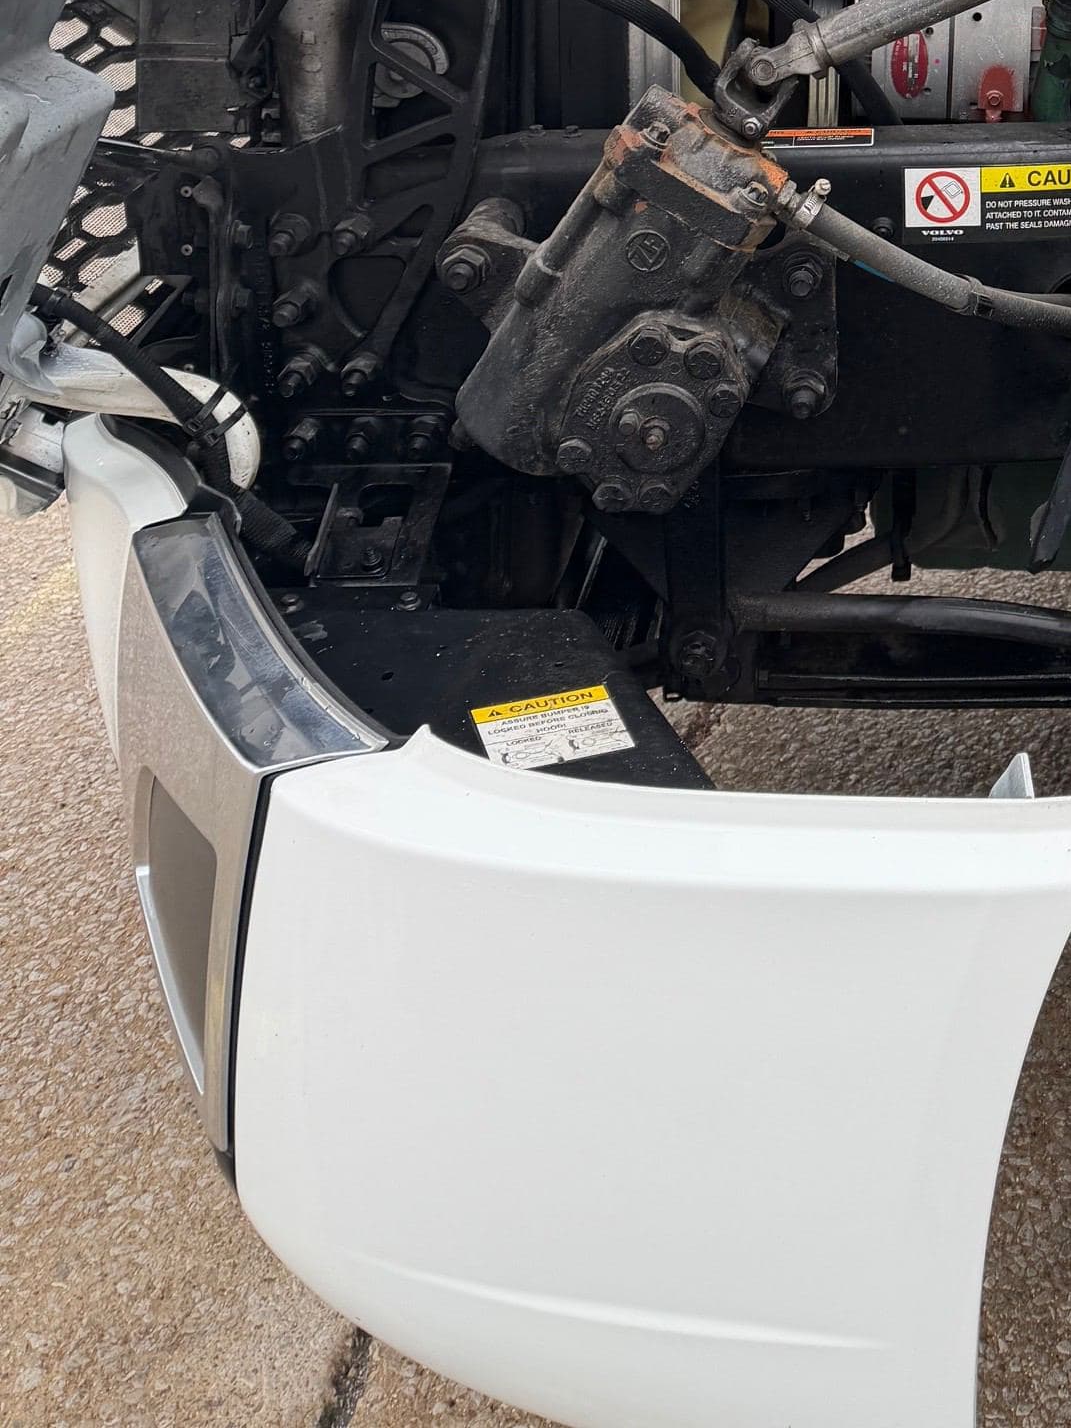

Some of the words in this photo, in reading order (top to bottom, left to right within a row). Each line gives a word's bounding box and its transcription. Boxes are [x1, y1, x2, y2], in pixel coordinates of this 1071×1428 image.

[985, 200, 997, 209] DO
[998, 200, 1012, 208] NOT
[1014, 198, 1051, 208] PRESSURE
[985, 210, 1022, 220] ATTACHED
[1023, 210, 1032, 219] TO
[985, 222, 1003, 230] PAST
[1005, 221, 1018, 230] THE
[1020, 220, 1043, 229] SEALS
[508, 691, 594, 713] CAUTION
[501, 713, 540, 725] ASSURE
[540, 706, 581, 720] BUMPER
[487, 722, 527, 735] LOCKED
[528, 716, 567, 728] BEFORE
[506, 735, 543, 746] LOCKED
[567, 721, 614, 734] RELEASED
